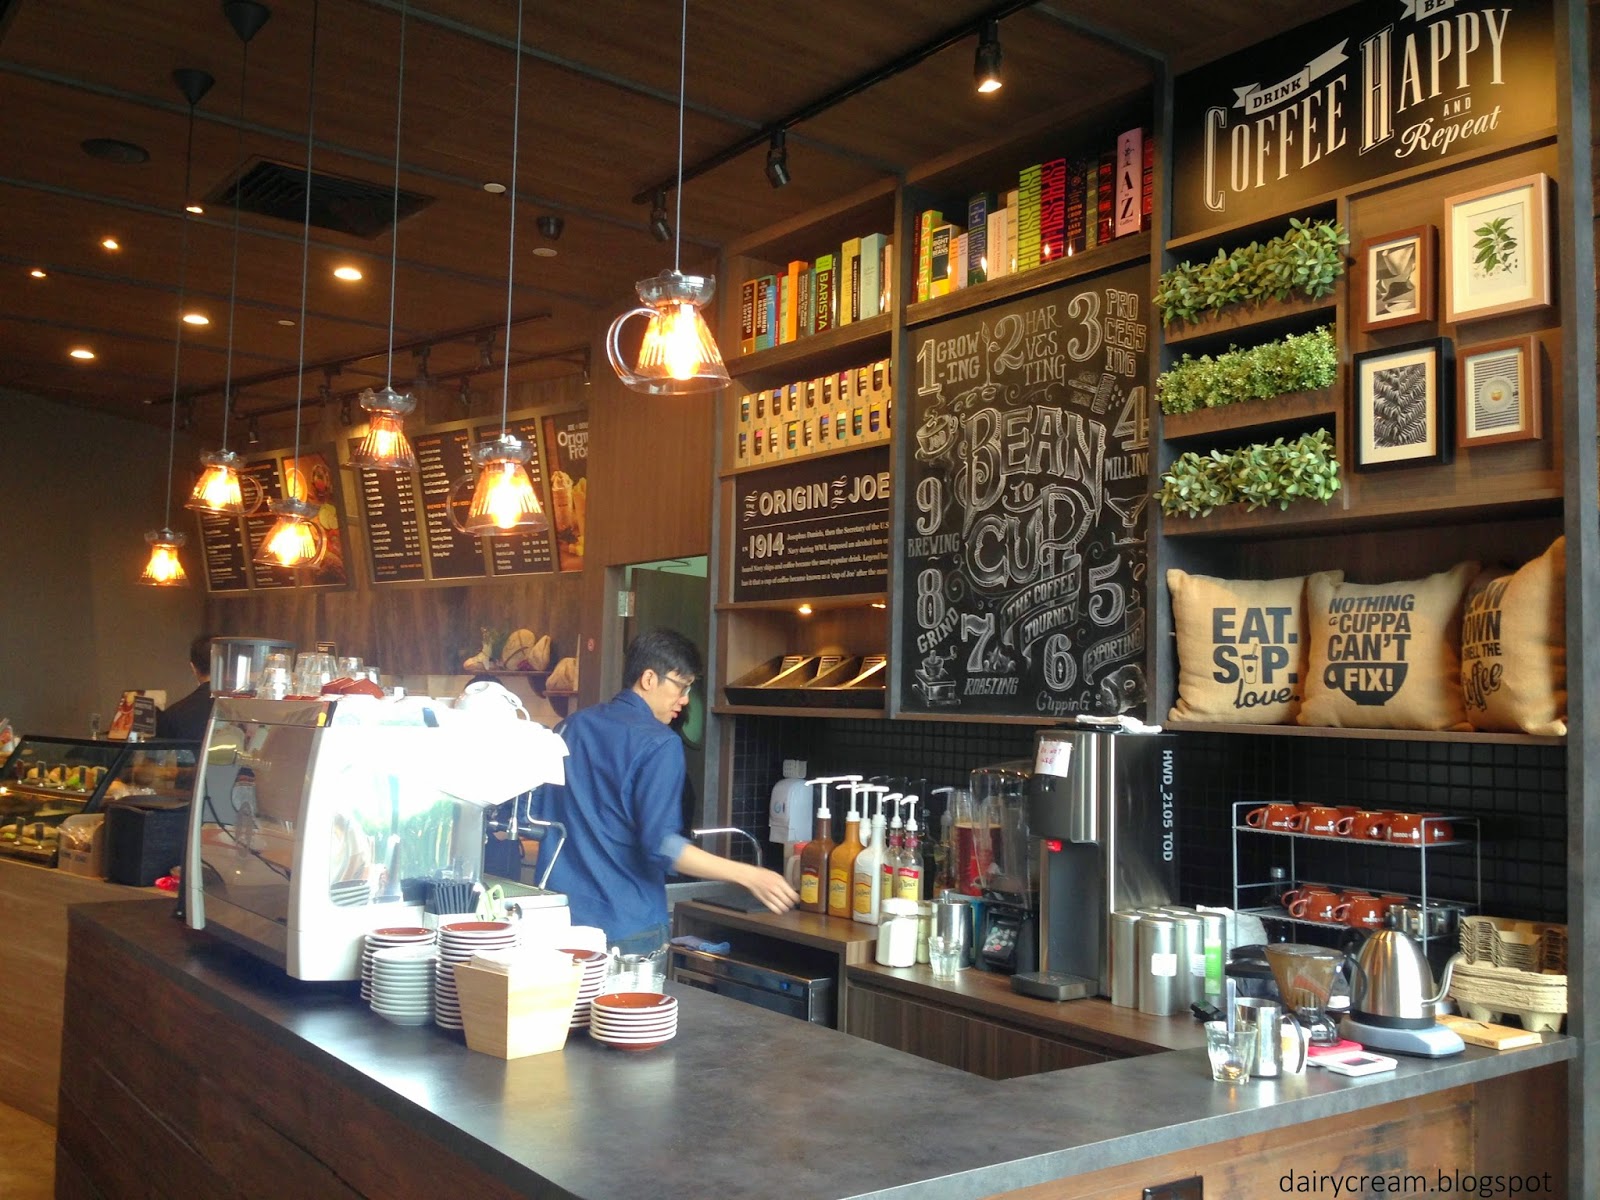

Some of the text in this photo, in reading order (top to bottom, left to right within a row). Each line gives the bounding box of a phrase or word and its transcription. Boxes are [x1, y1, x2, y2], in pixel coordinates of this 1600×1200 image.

[1204, 8, 1513, 212] COFFEE HAPPY
[1252, 77, 1302, 109] DRINK
[1443, 97, 1472, 117] AND
[1395, 105, 1502, 159] Repeat
[1120, 196, 1134, 220] Z
[818, 272, 829, 331] BARISTA
[994, 305, 1062, 375] 2 HAR
[1067, 288, 1139, 362] 3 PRO
[1104, 318, 1147, 353] CESS
[1025, 330, 1059, 361] VES
[1104, 346, 1137, 378] ING
[916, 332, 980, 397] 1 GROW
[1023, 355, 1067, 387] TING
[1112, 385, 1150, 452] 4
[955, 404, 1107, 535] BEAN
[1104, 452, 1150, 481] MILLIN
[758, 482, 828, 517] ORIGIN
[848, 472, 890, 504] JOE
[916, 476, 942, 535] 9
[1010, 480, 1034, 503] TO
[749, 532, 785, 559] 1914
[907, 533, 960, 558] BREWING
[965, 485, 1094, 588] CUP
[916, 568, 945, 630] 8
[1006, 572, 1076, 618] THE COFFEE
[1088, 554, 1126, 627] 5
[1328, 593, 1415, 615] NOTHING
[916, 607, 960, 654] GRIND
[1024, 602, 1077, 643] JOURNEY
[1212, 606, 1298, 645] EAT.
[1329, 612, 1412, 634] a CUPPA
[1463, 610, 1502, 645] OWN
[961, 612, 996, 673] 7
[1087, 627, 1141, 663] EXPORTING
[1327, 633, 1412, 662] CAN'T
[1481, 642, 1502, 657] THE
[1044, 633, 1078, 692] 6
[1344, 667, 1394, 692] FIX!
[963, 677, 1019, 695] ROASTING
[1162, 831, 1174, 862] TOD
